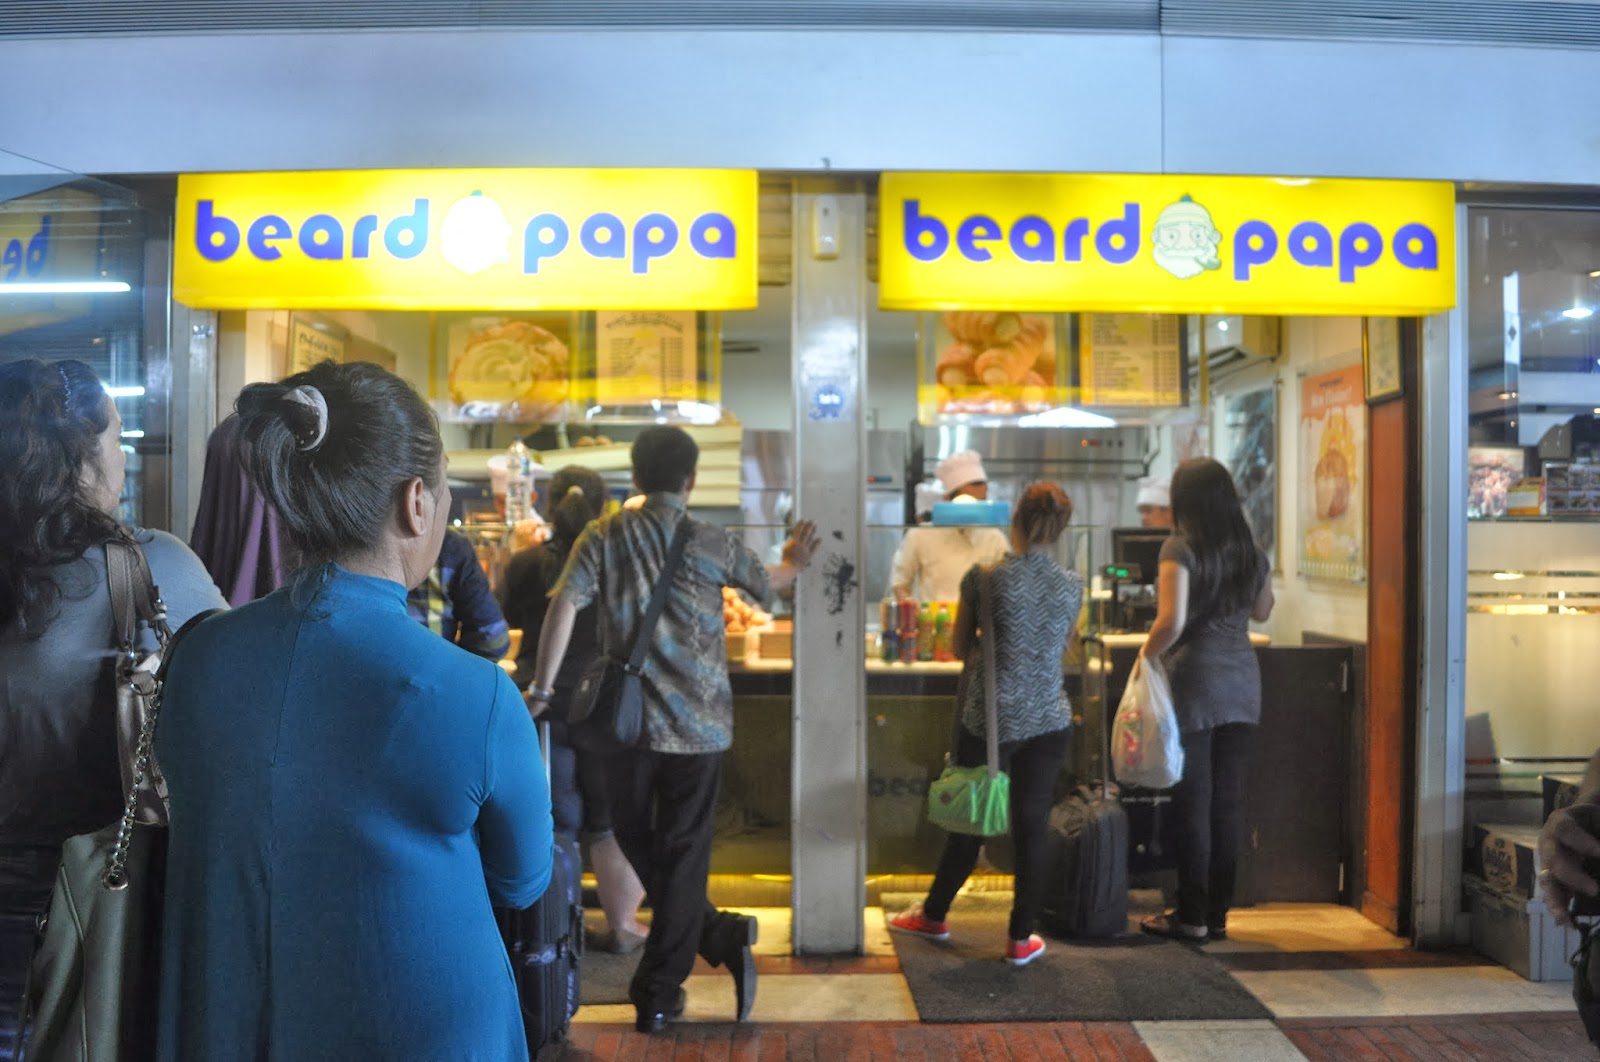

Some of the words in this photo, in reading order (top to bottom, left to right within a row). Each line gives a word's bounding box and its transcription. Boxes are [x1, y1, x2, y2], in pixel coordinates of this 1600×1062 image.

[195, 199, 430, 261] beard
[523, 212, 736, 275] papa
[903, 200, 1140, 265] beard
[1233, 220, 1438, 283] papa
